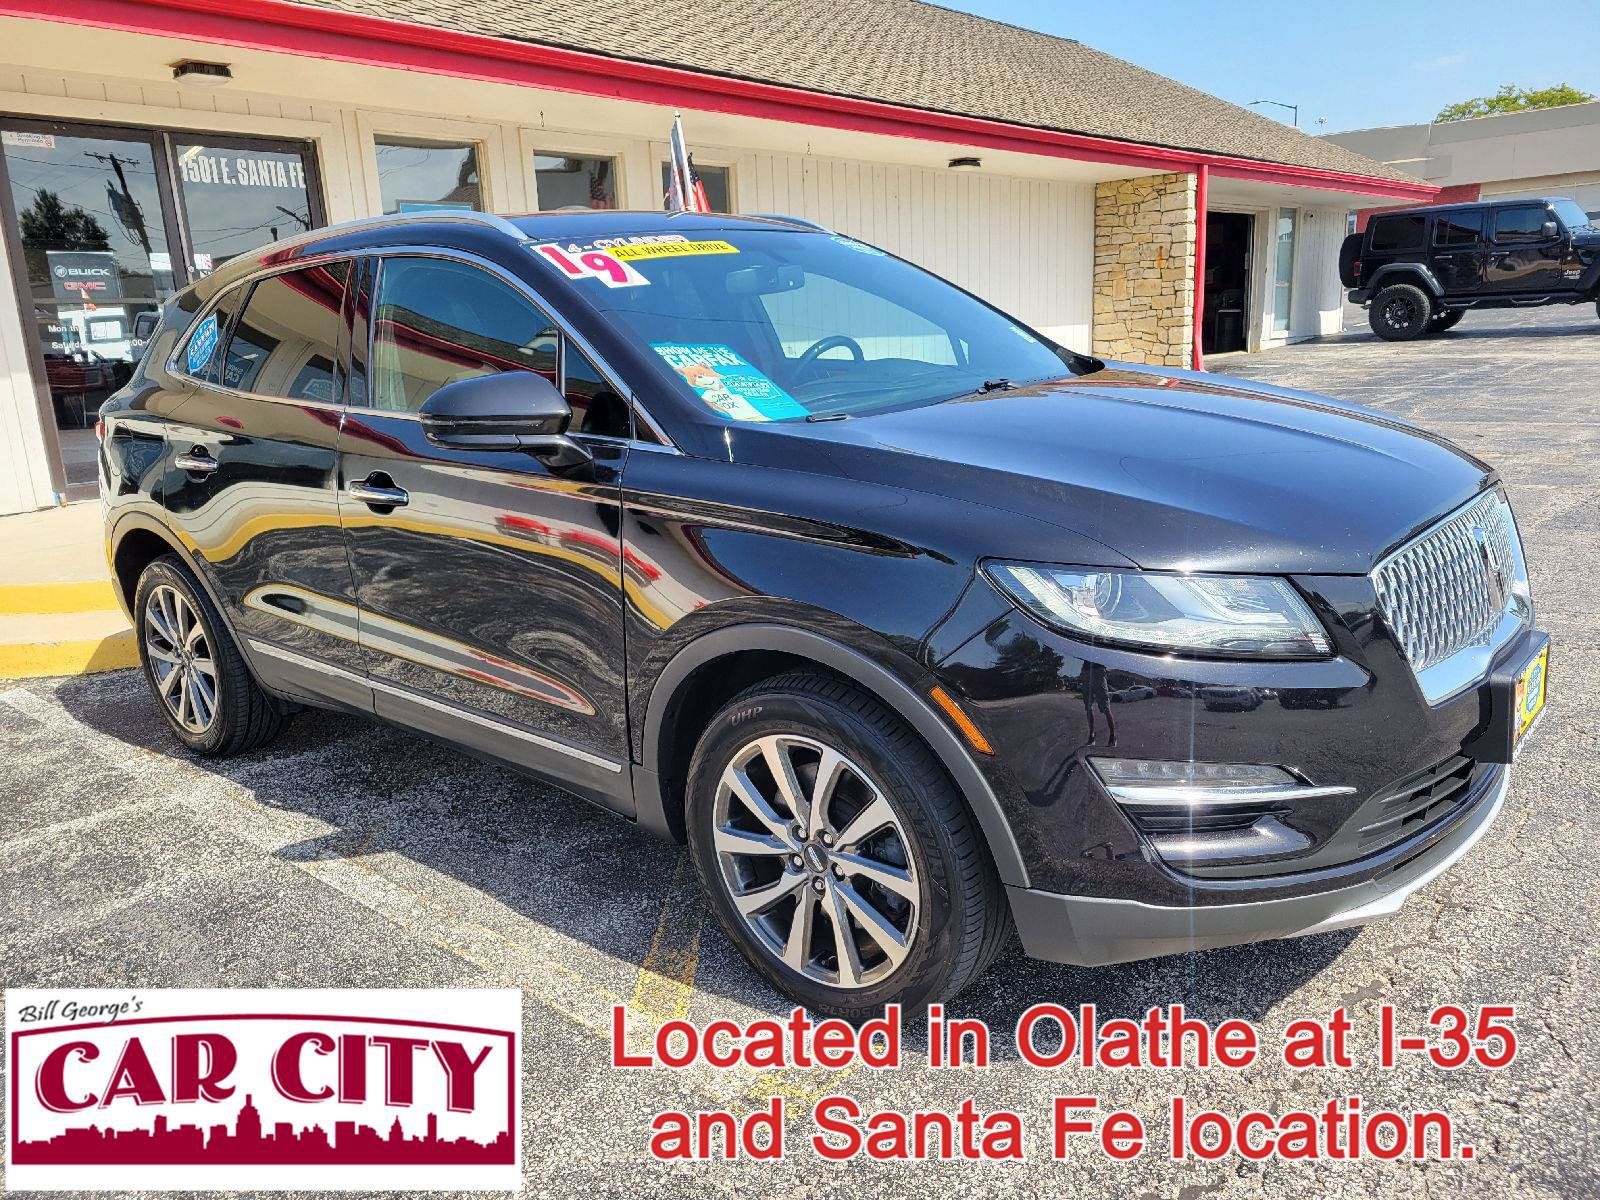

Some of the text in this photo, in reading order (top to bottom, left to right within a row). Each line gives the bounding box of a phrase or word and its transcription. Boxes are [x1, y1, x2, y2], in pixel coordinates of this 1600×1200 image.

[179, 155, 306, 189] 1501 E. SANTA FE
[614, 243, 730, 258] ALL WHEEL DRIVE
[68, 268, 110, 276] BUICK
[47, 325, 67, 333] Mon
[664, 352, 748, 368] CARFAX
[731, 706, 763, 727] UHP
